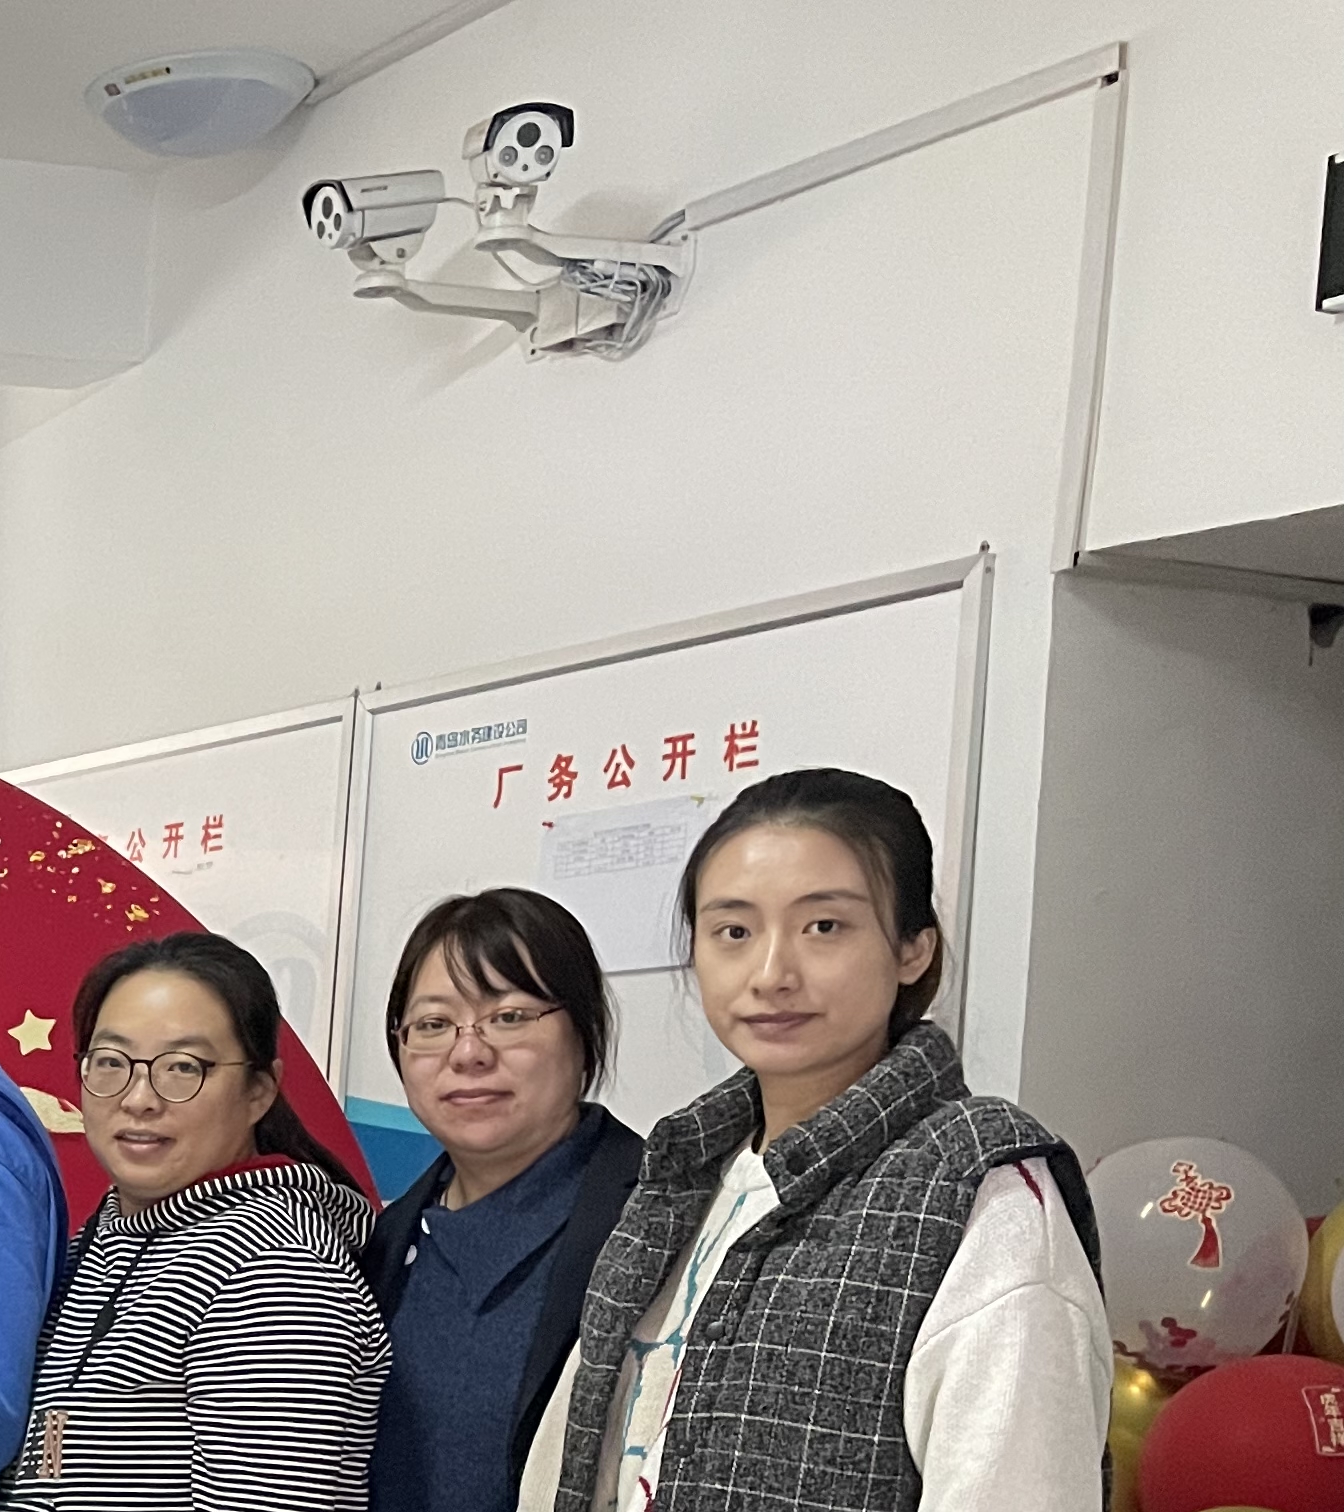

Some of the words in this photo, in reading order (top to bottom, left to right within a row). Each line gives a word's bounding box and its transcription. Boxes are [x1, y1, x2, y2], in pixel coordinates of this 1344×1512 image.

[492, 719, 760, 809] 厂务公开栏
[99, 814, 224, 863] 公开栏
